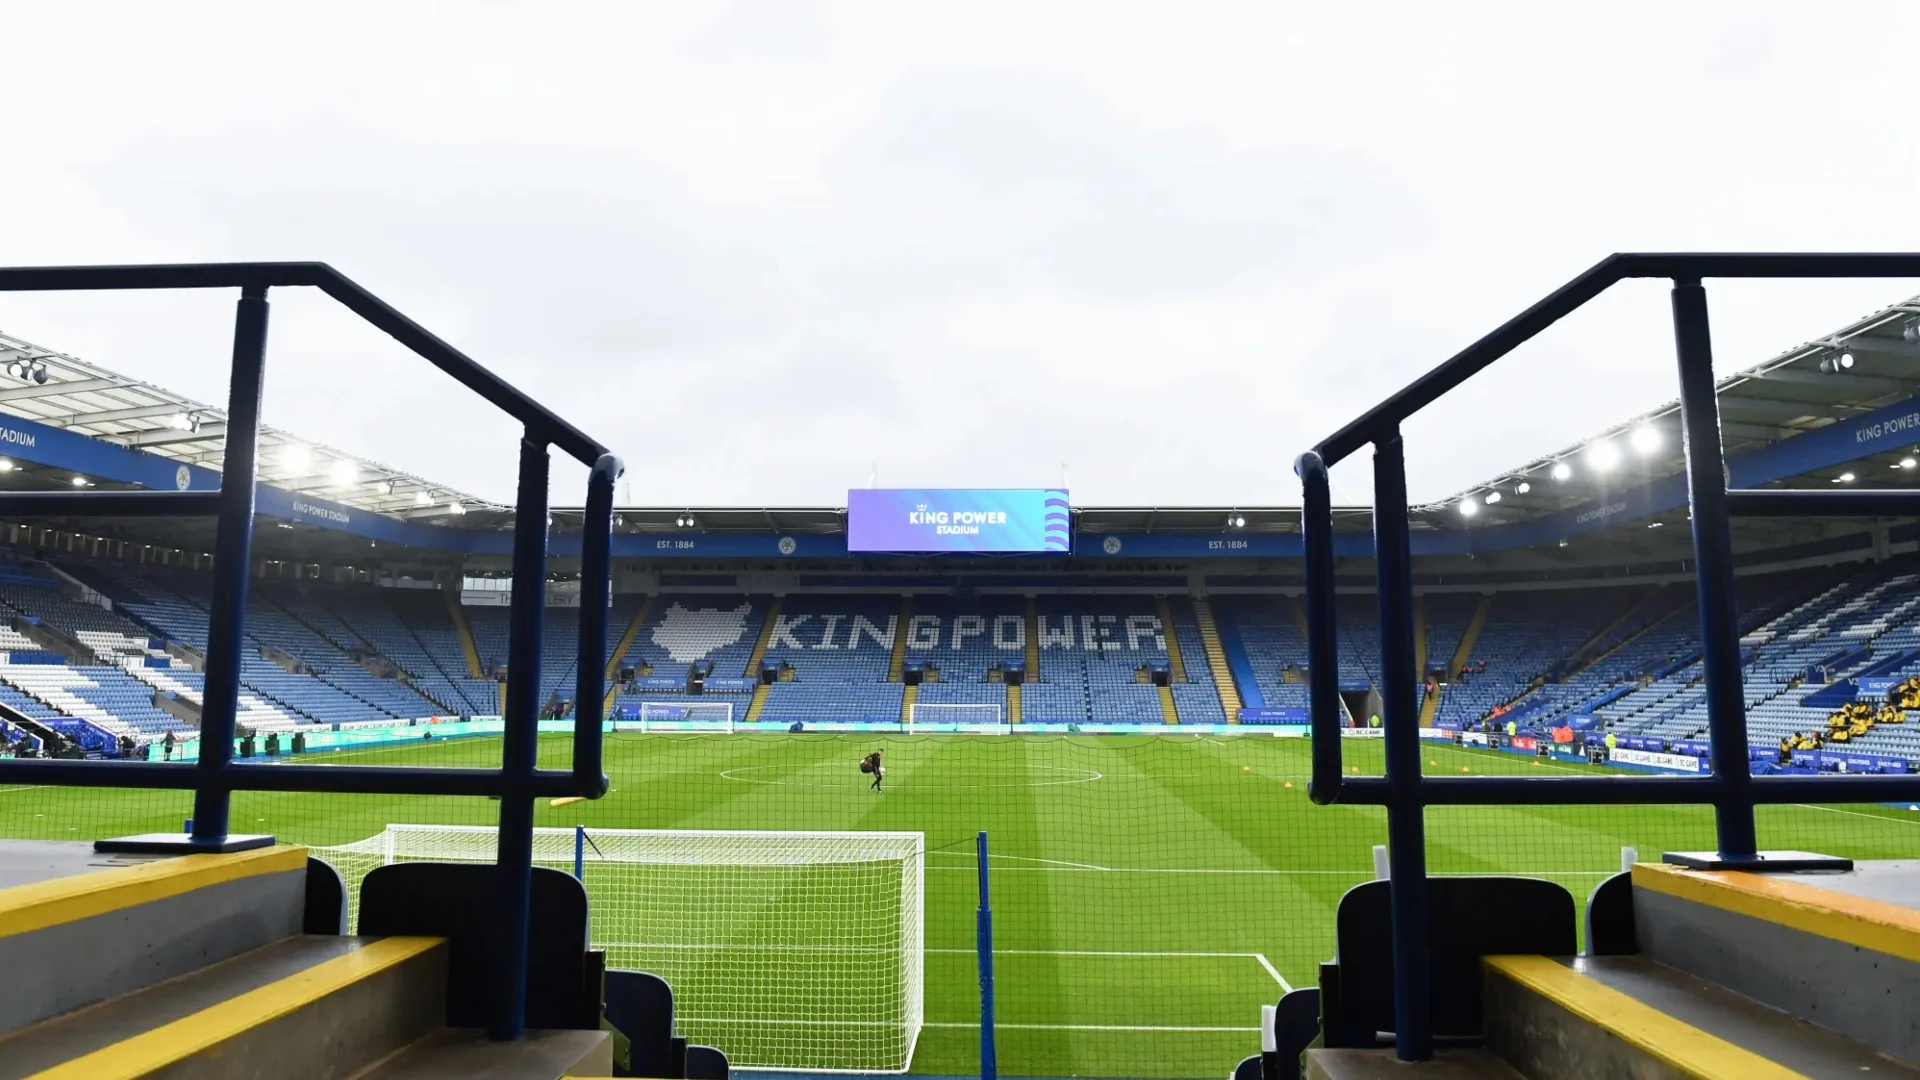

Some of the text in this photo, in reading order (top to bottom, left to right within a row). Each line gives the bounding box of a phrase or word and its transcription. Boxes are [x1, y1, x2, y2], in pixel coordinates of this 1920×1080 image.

[1856, 412, 1920, 443] KING POWER
[0, 426, 35, 448] TADIUM
[909, 511, 1007, 524] KING POWER
[936, 525, 979, 535] STADIUM
[657, 540, 694, 549] EST. 1884
[1208, 540, 1248, 549] EST. 1884
